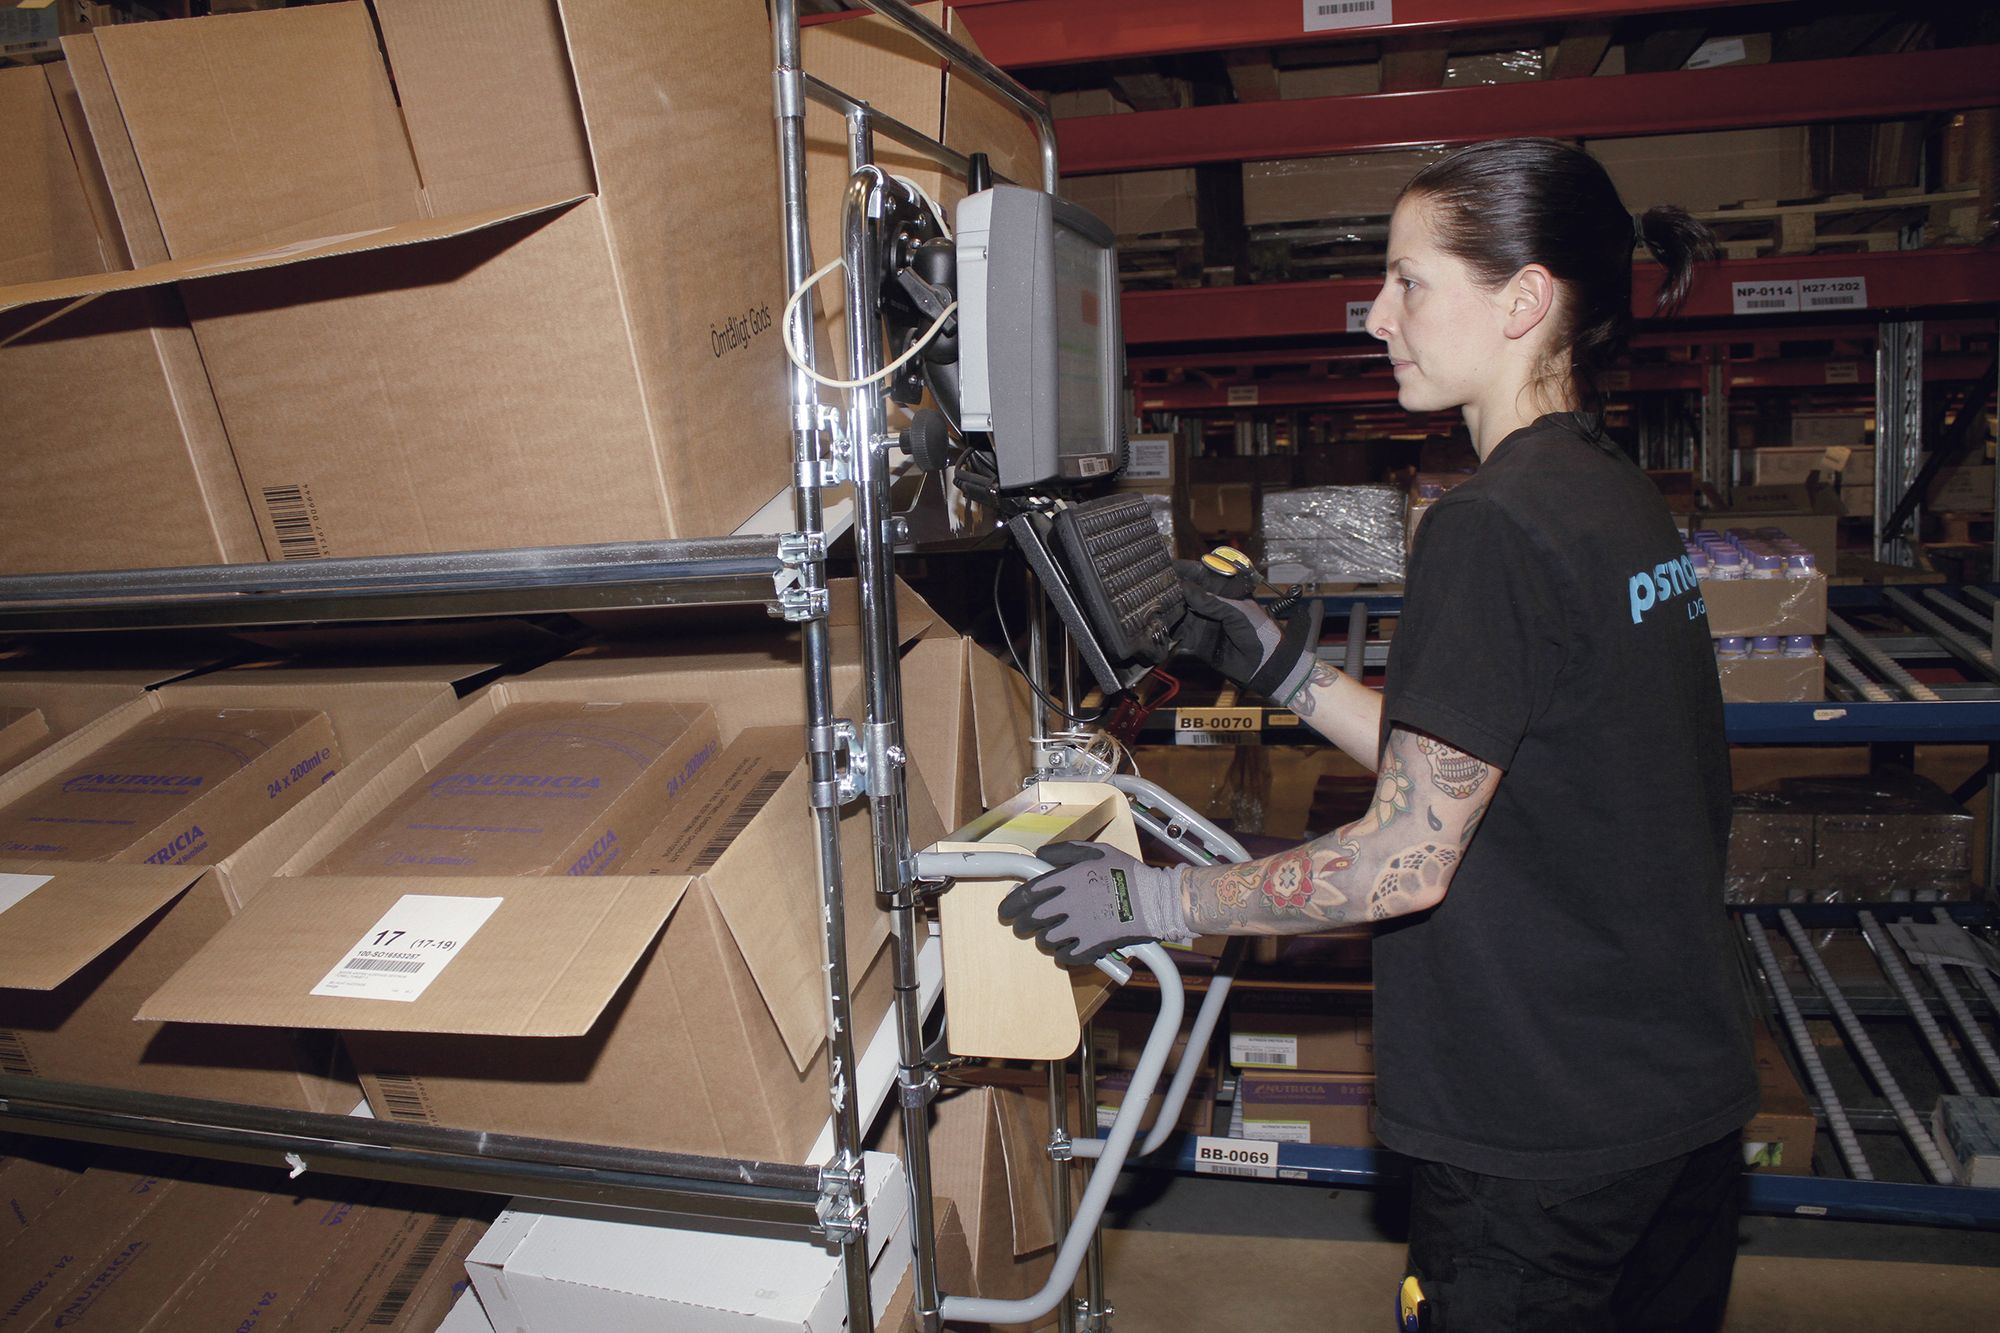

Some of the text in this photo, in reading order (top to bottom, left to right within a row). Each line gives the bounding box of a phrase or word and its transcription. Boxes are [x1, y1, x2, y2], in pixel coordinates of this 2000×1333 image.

[1736, 286, 1794, 298] NP-0114
[1802, 281, 1861, 294] H27-1202
[710, 301, 773, 358] Ömtåligt Gods
[1180, 717, 1254, 730] BB-0070
[86, 774, 205, 787] NUTRICIA
[267, 778, 282, 799] 24
[284, 776, 292, 789] x
[290, 752, 322, 783] 200ml
[456, 773, 602, 789] NUTRICIA
[371, 929, 458, 952] 17 (17-19)
[1266, 1085, 1326, 1095] NUTRICIA
[1201, 1147, 1269, 1165] BB-0069
[54, 1254, 75, 1269] 24
[63, 1240, 143, 1315] NUTRICIA
[257, 1291, 278, 1306] 24
[249, 1308, 261, 1317] x
